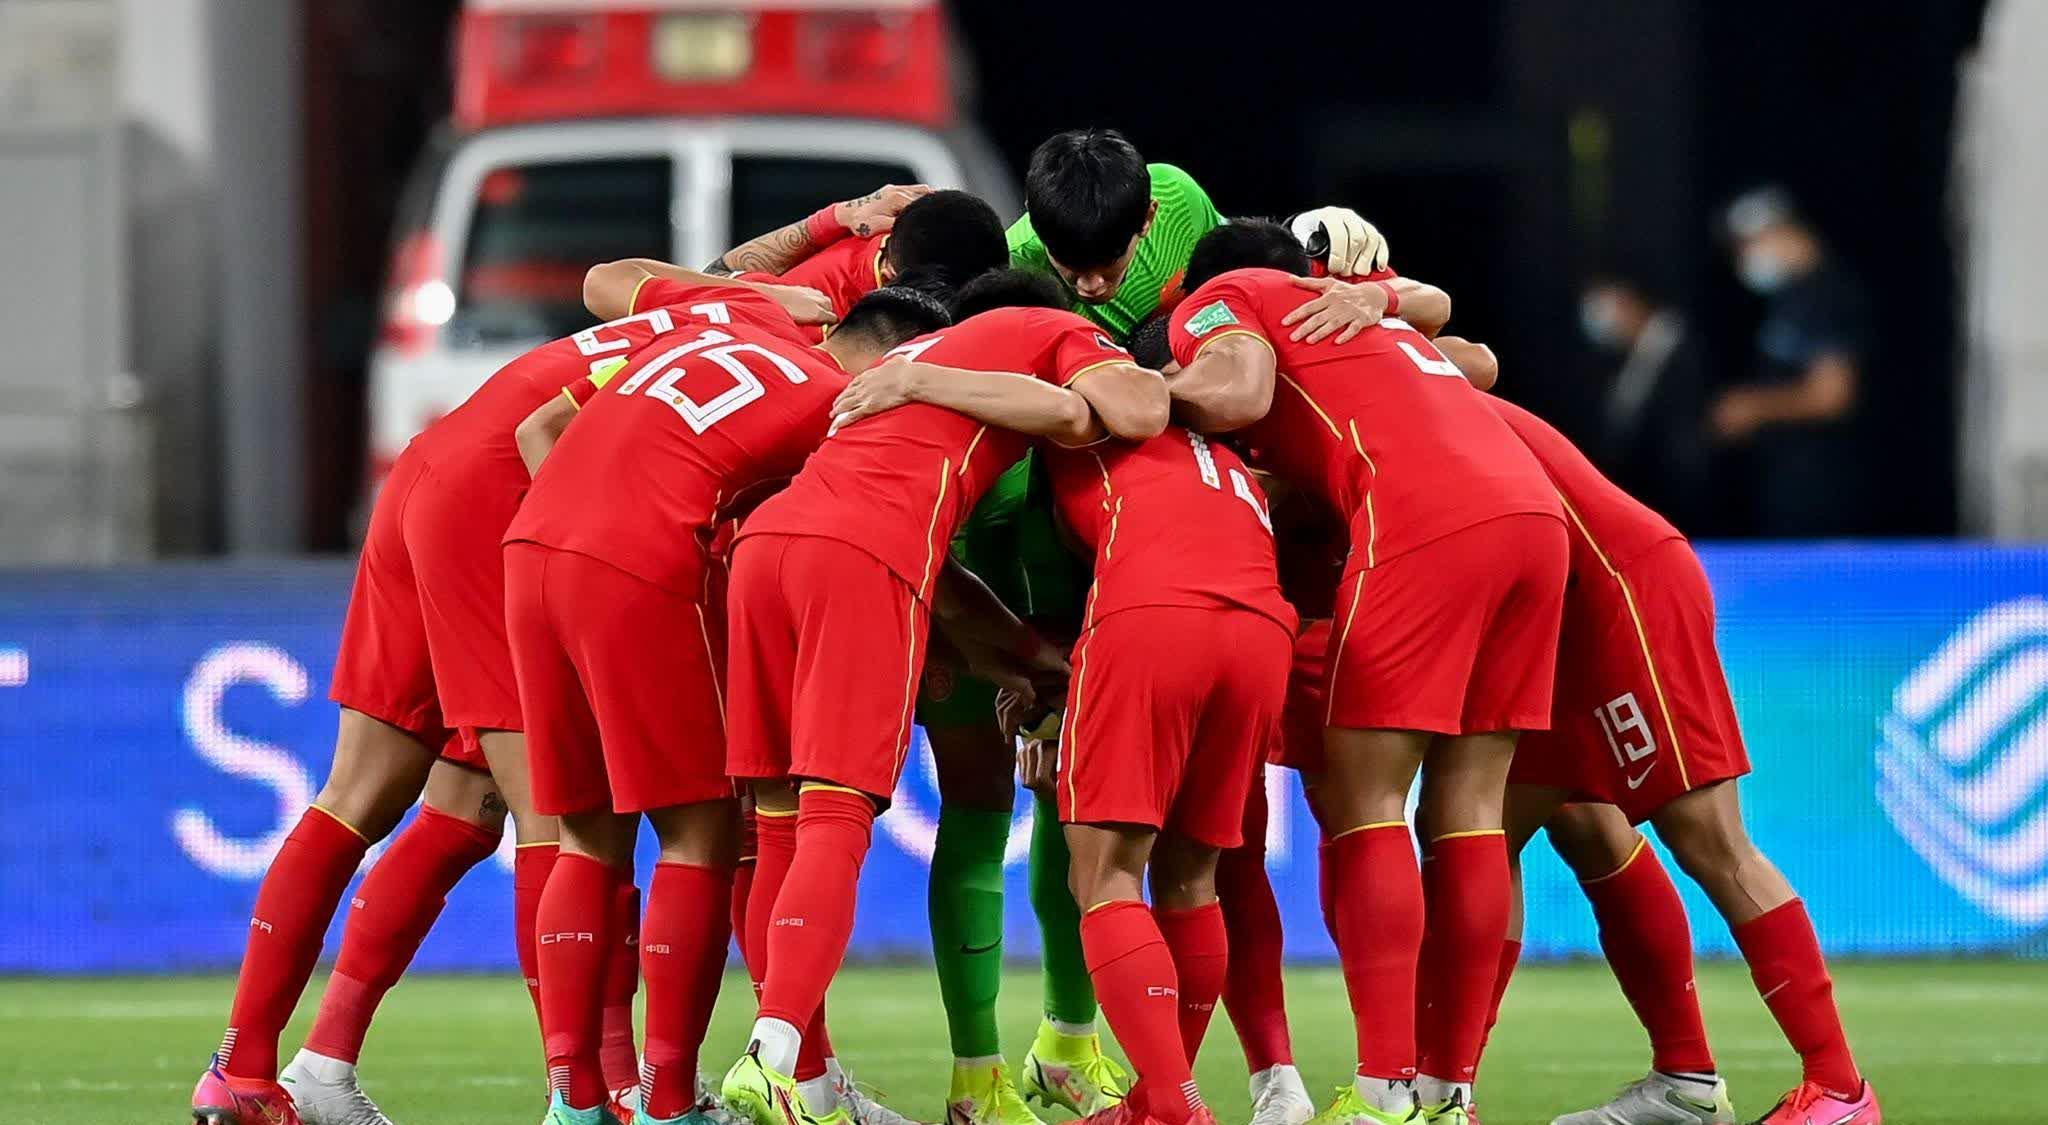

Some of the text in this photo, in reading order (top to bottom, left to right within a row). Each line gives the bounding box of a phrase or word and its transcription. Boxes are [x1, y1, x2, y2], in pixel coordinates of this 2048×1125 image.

[616, 329, 810, 436] 15
[1593, 692, 1657, 768] 19
[250, 917, 273, 934] FA
[541, 932, 593, 945] CFA
